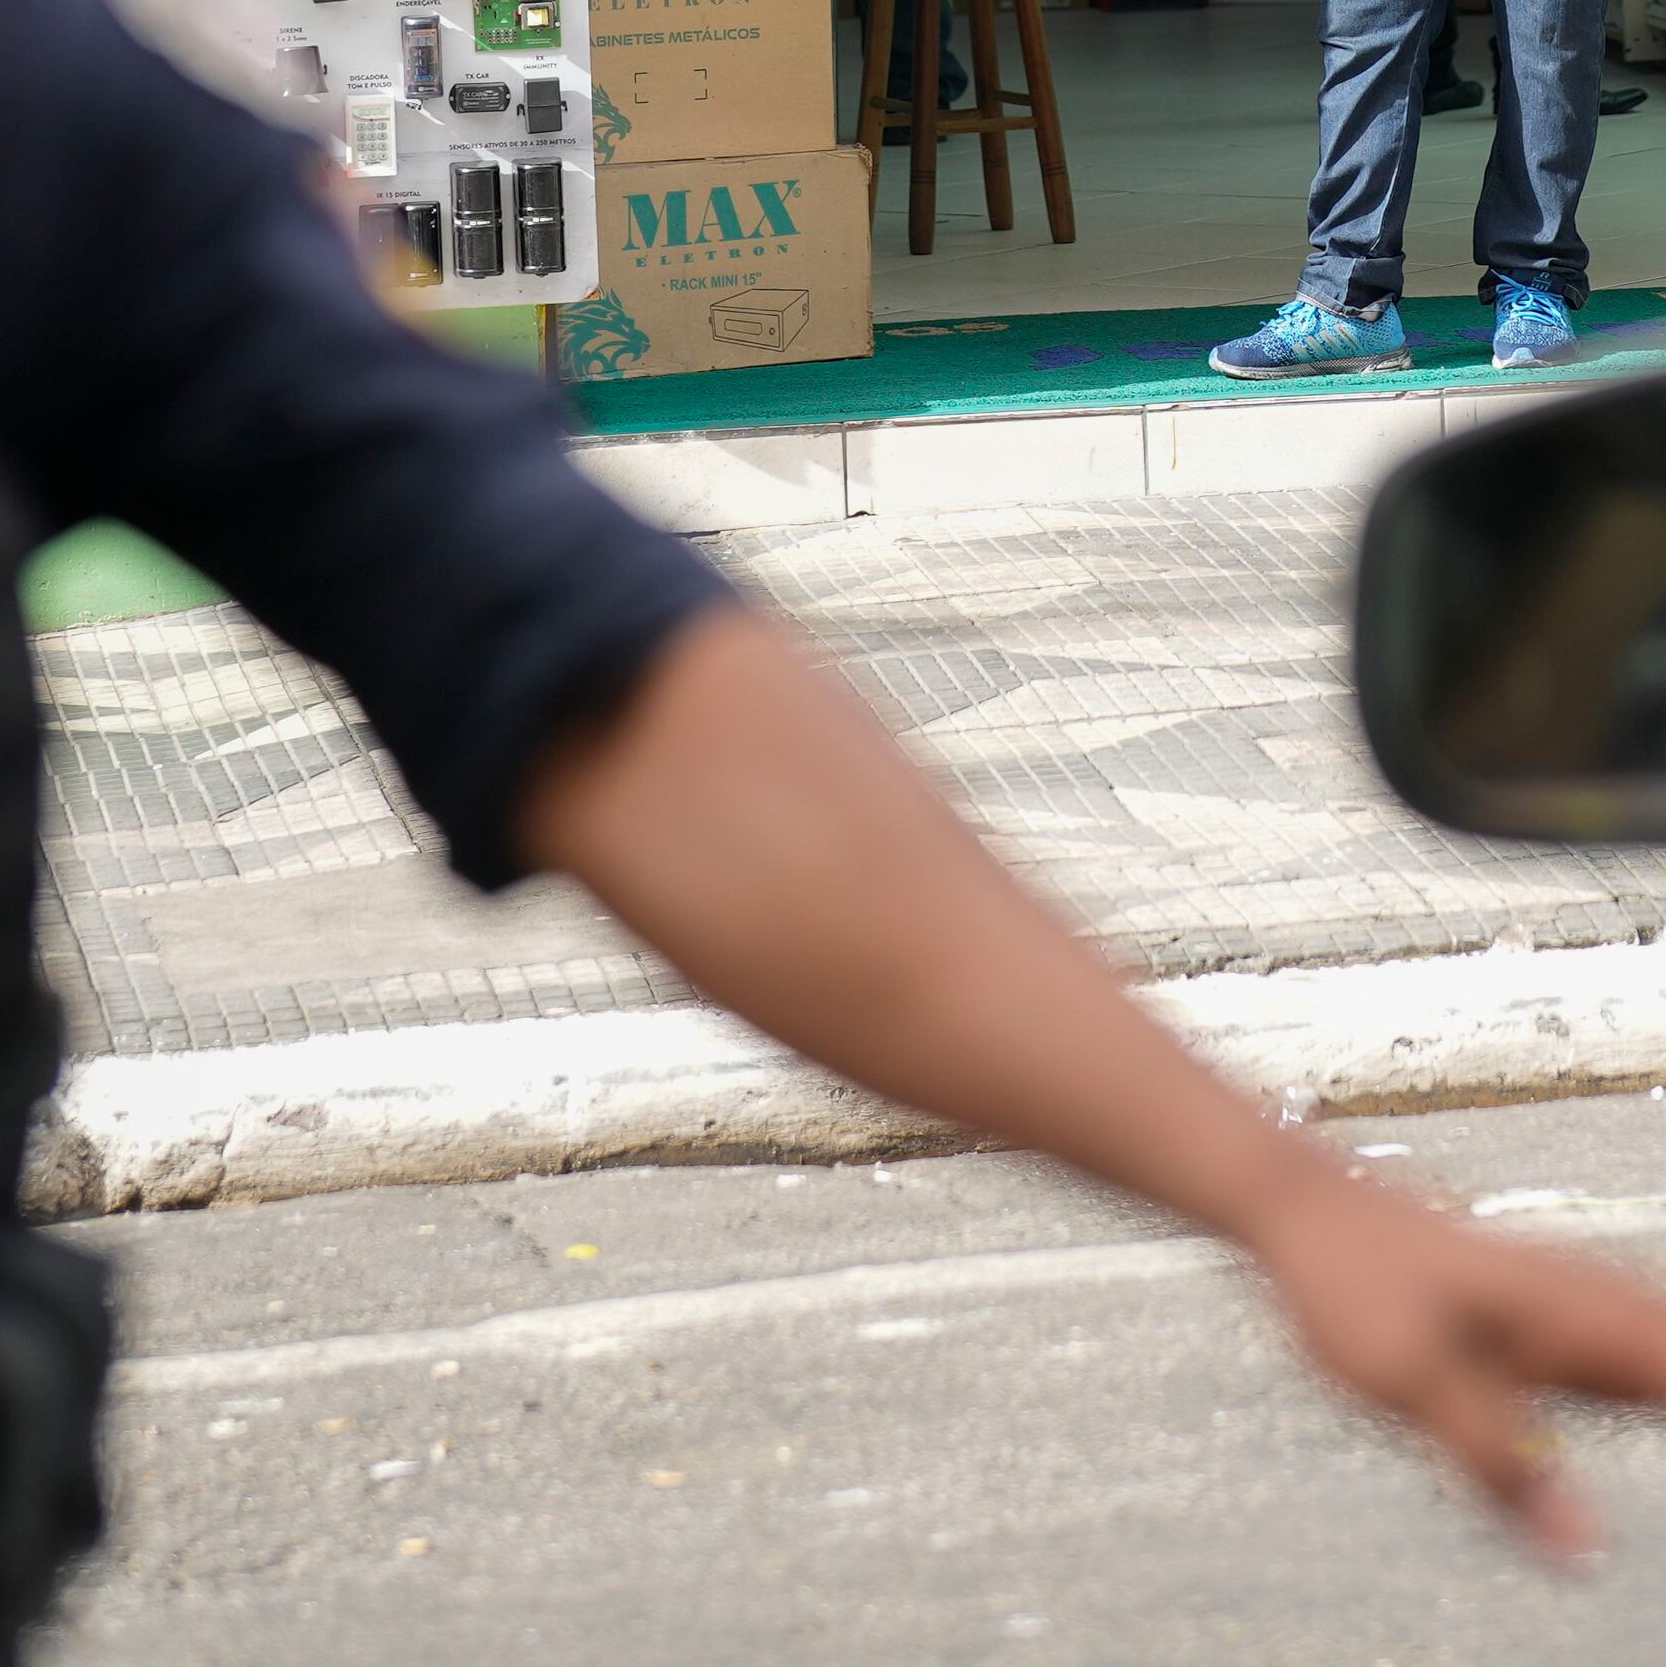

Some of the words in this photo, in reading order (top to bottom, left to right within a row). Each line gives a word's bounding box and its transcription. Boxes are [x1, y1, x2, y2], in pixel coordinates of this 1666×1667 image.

[588, 31, 665, 48] ABINETES
[668, 25, 761, 43] METÁLICOS
[349, 74, 389, 82] DISCADORA
[370, 81, 392, 89] PULSO
[484, 141, 509, 149] ATIVOS
[549, 138, 577, 146] METROS
[394, 190, 422, 198] DIGITAL
[621, 179, 801, 251] MAX
[635, 243, 790, 268] ELETRON
[669, 277, 707, 292] RACK
[710, 274, 738, 289] MINI
